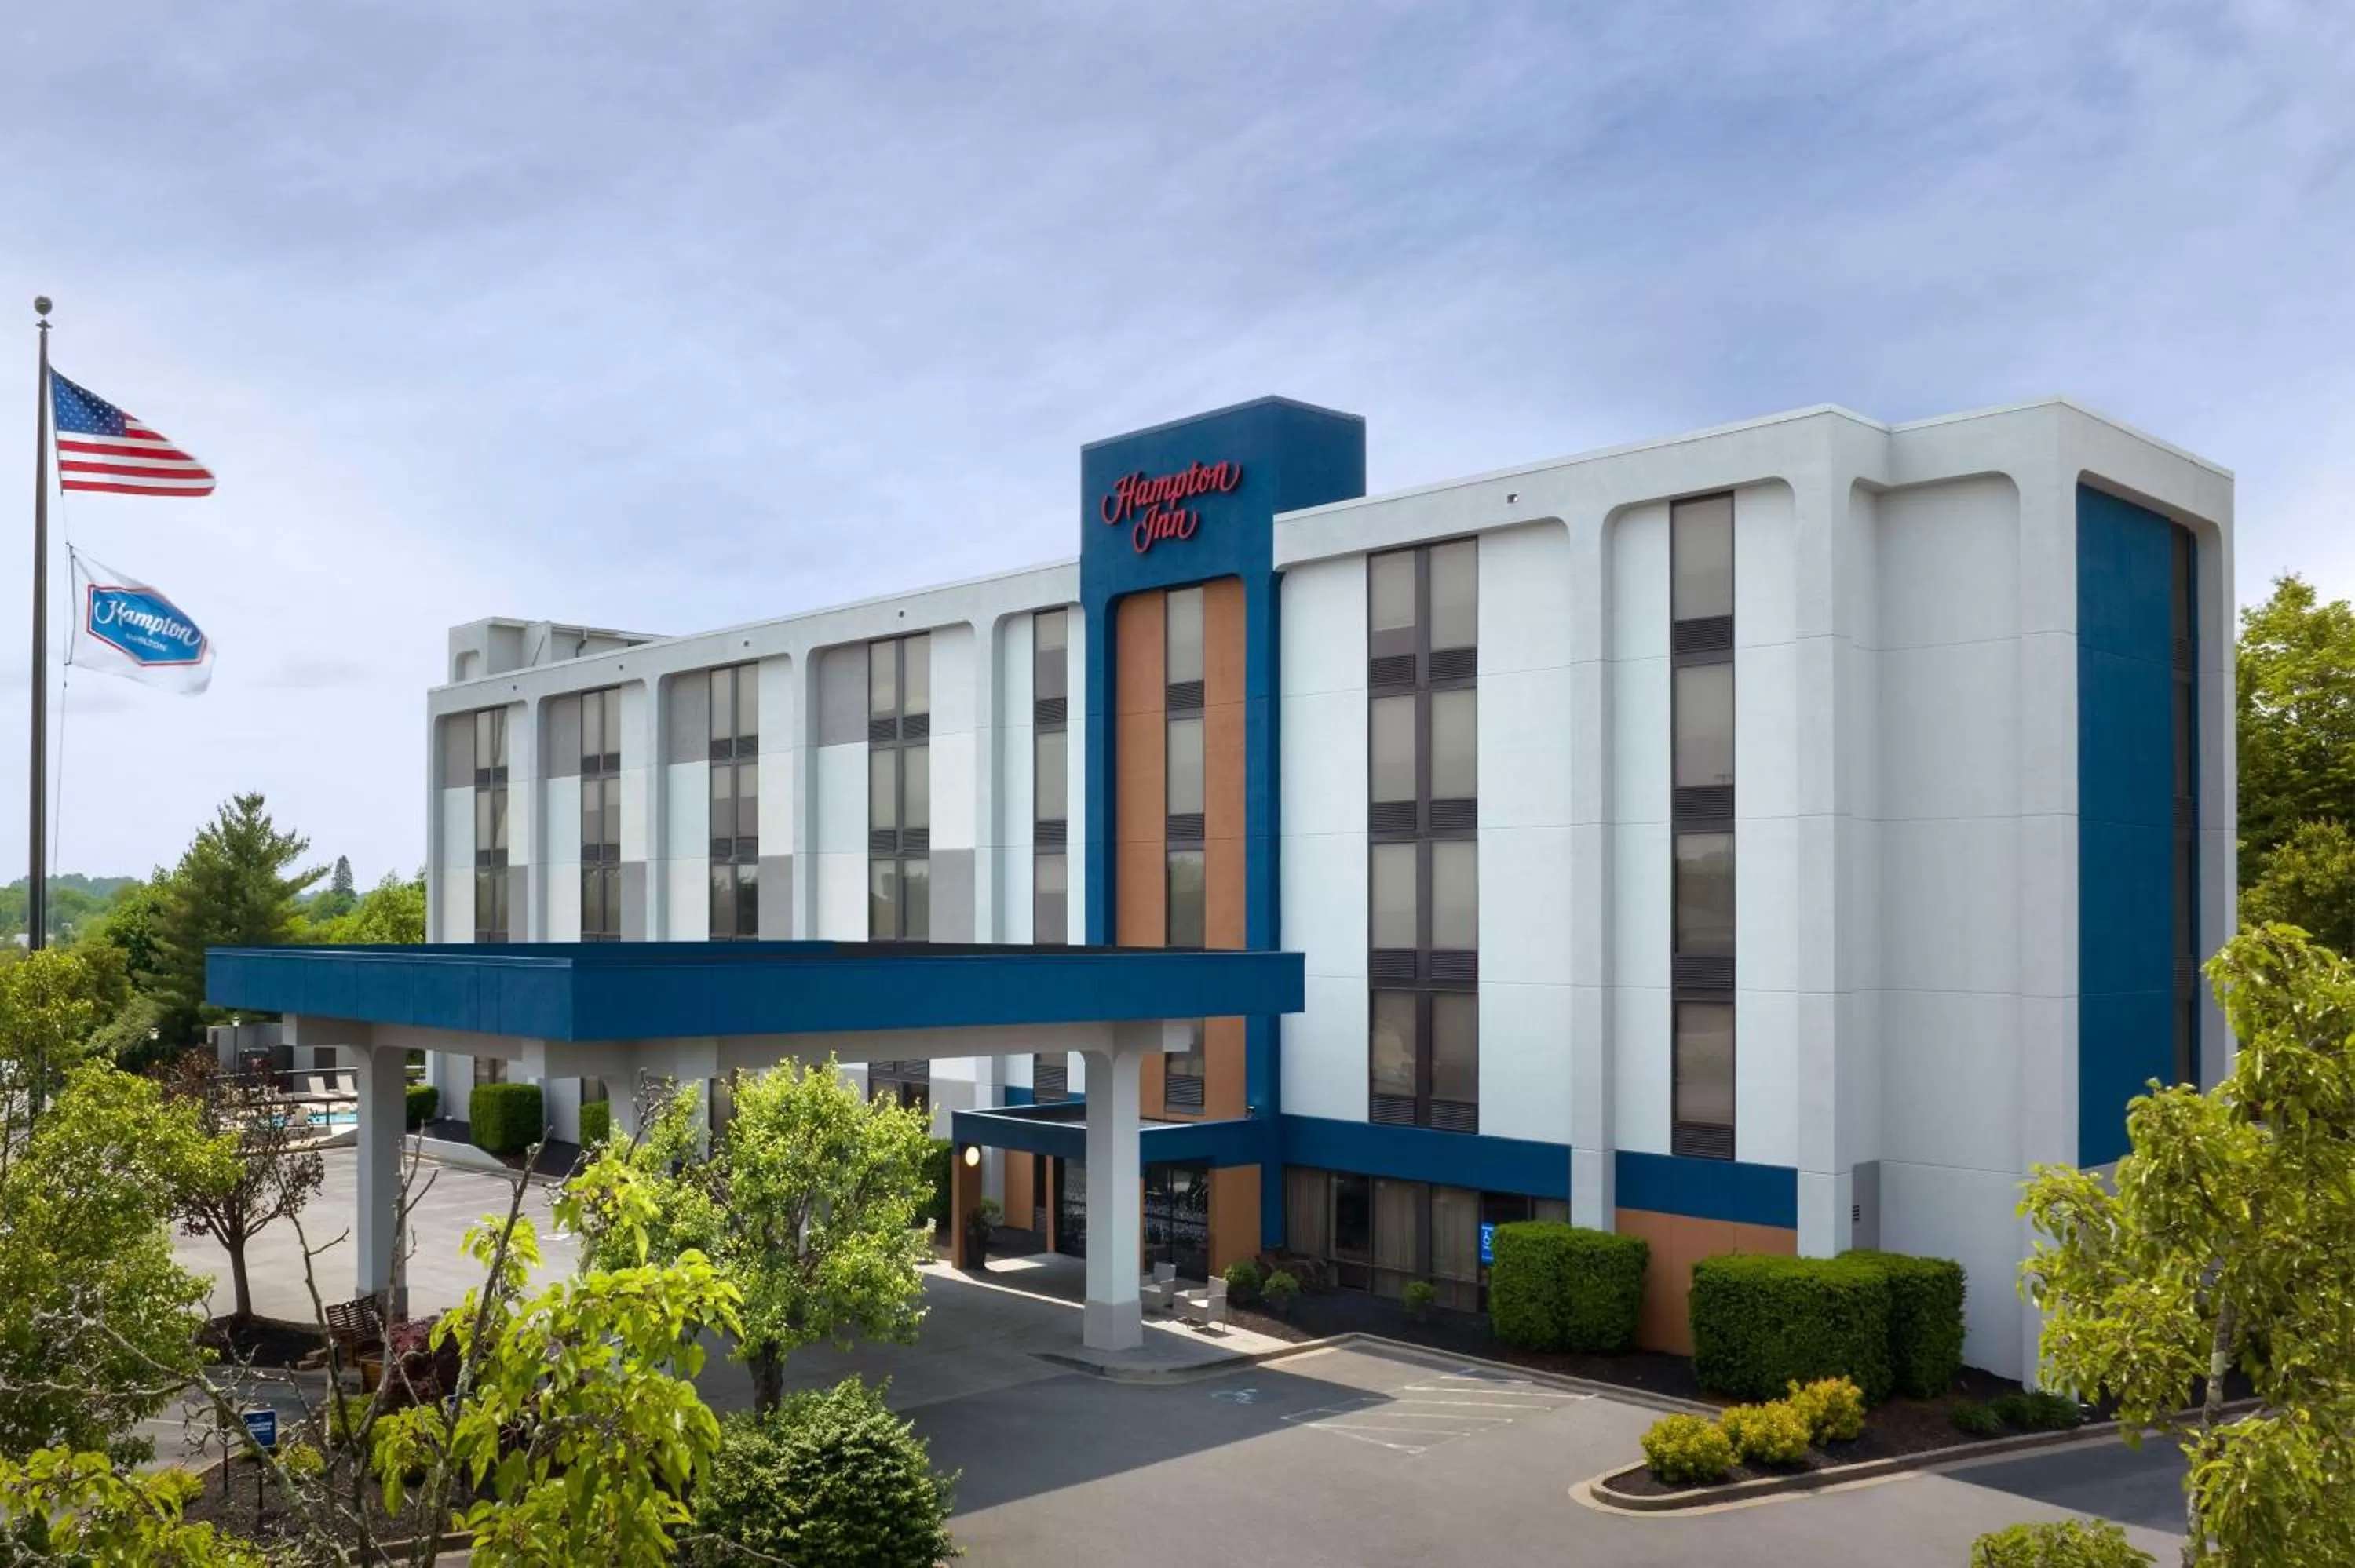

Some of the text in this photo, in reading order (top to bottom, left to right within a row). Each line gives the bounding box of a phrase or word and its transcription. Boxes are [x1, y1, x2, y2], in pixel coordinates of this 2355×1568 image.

[1102, 460, 1241, 525] Hampton
[1133, 503, 1199, 553] Inn
[94, 600, 202, 646] Hampton
